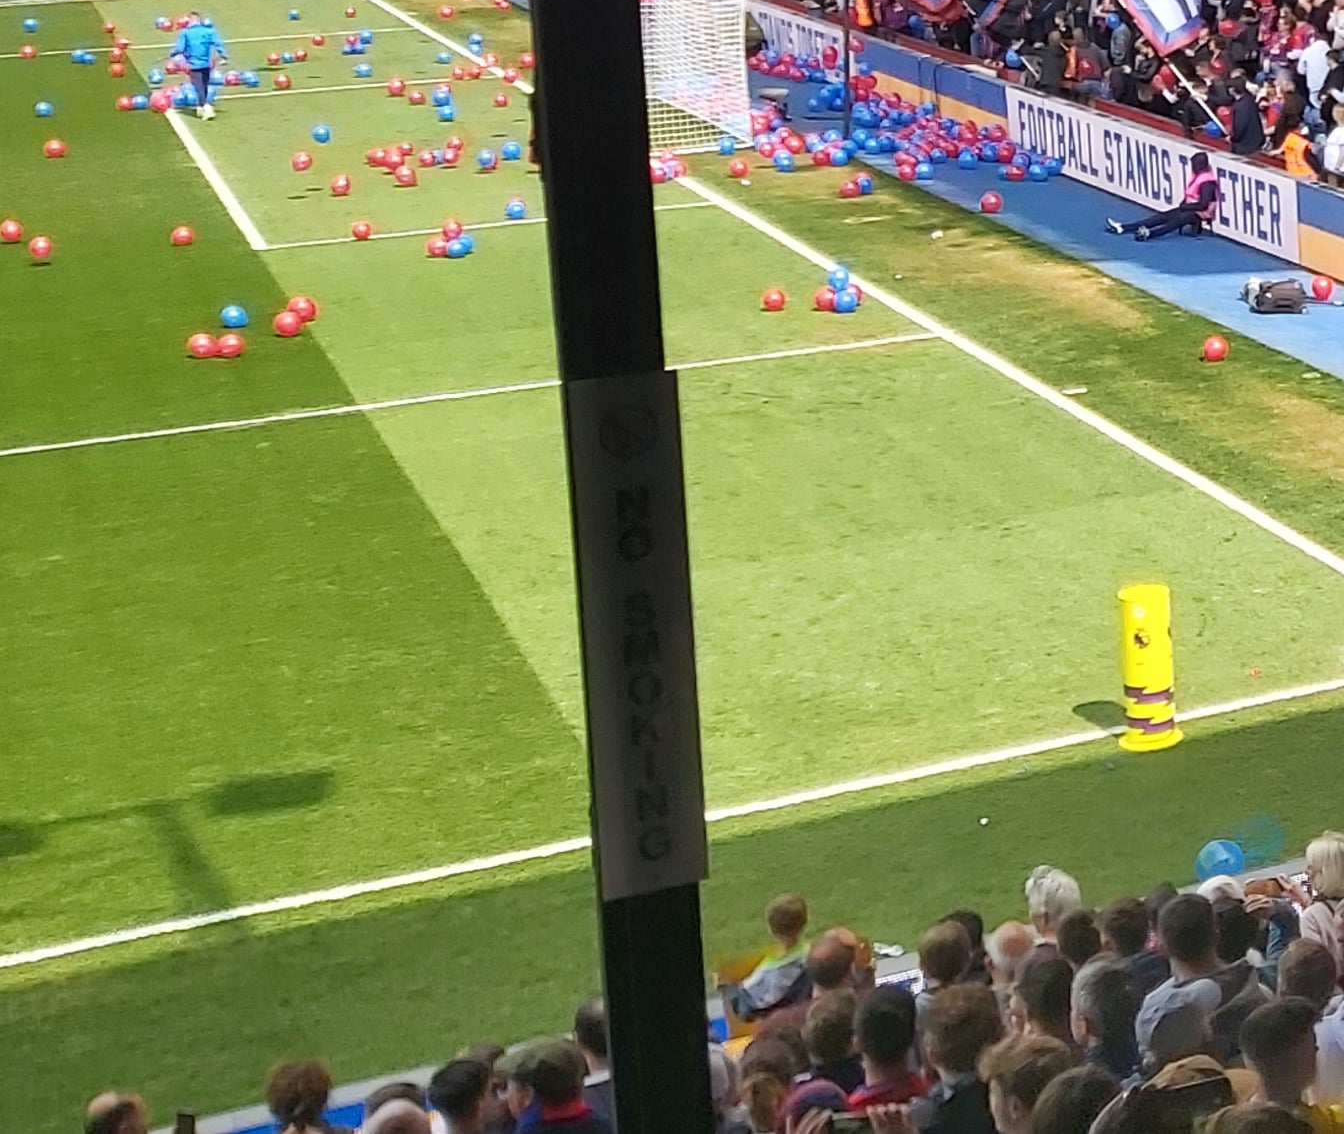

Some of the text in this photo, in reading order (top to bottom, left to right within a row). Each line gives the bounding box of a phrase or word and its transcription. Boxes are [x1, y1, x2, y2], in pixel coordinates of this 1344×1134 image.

[1017, 99, 1283, 247] FOOTBALL STANDS TETHER
